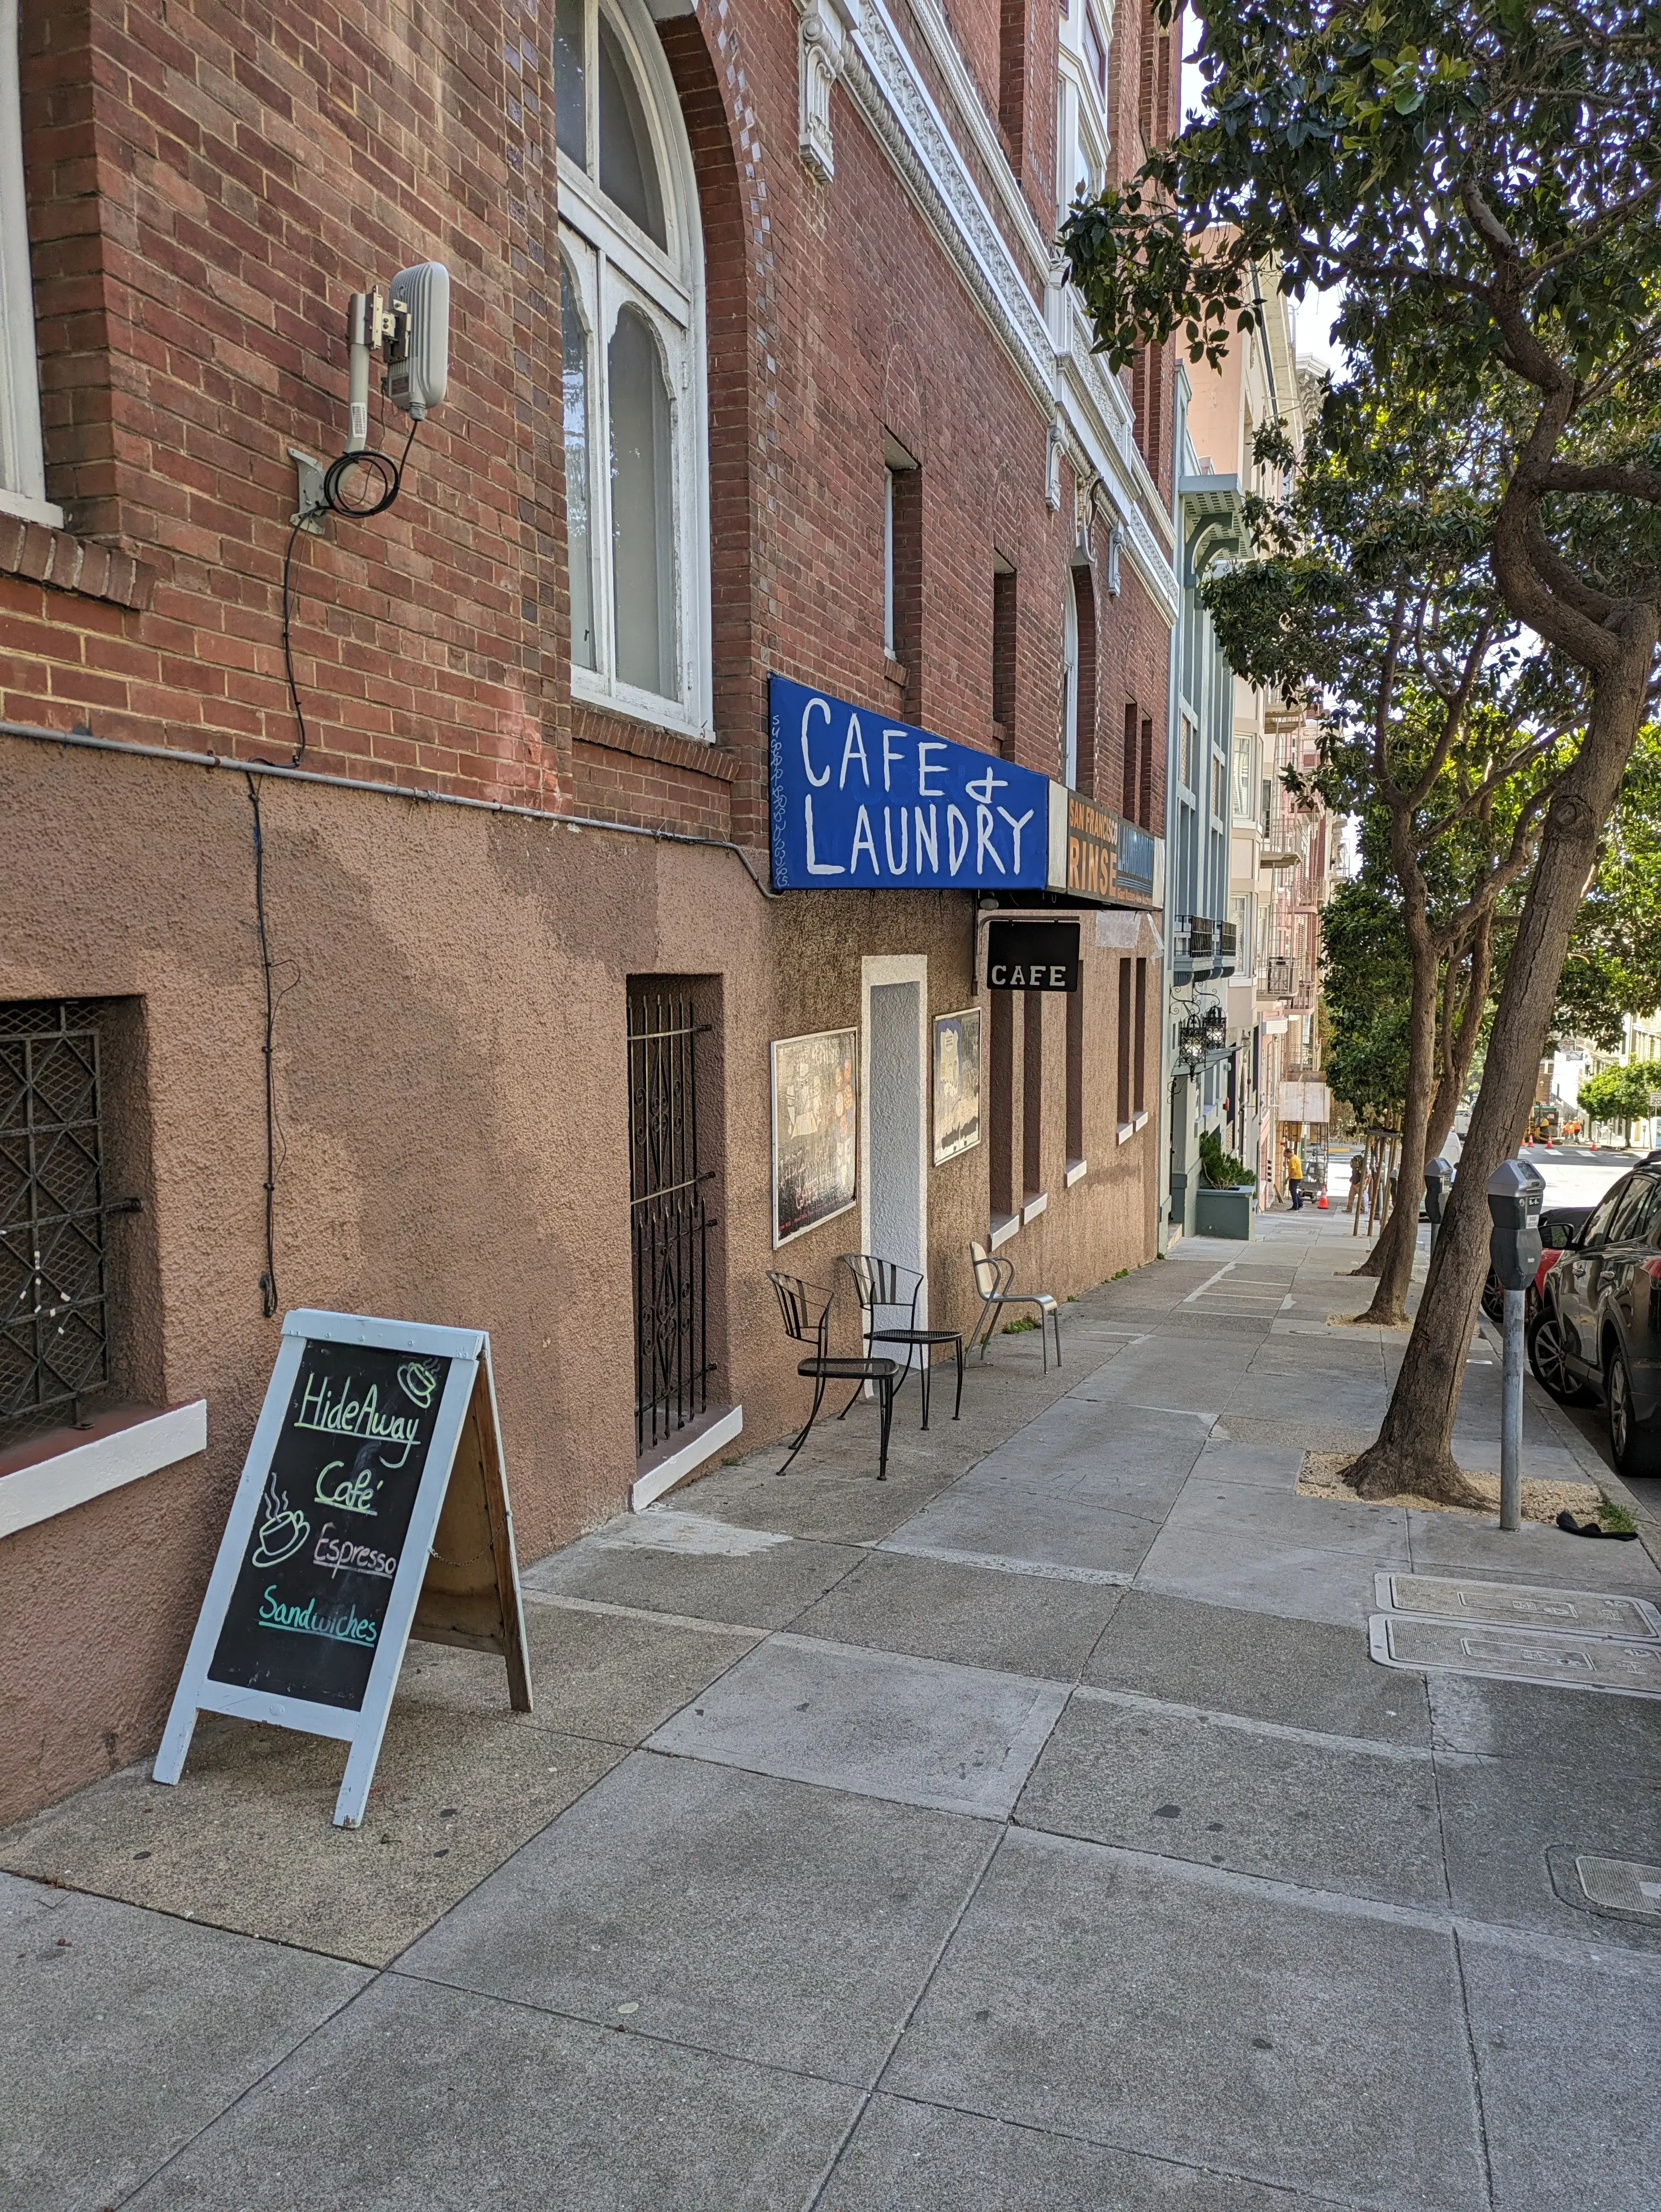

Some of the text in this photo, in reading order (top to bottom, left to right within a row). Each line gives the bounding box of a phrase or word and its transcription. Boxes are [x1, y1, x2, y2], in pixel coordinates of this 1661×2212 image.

[801, 697, 949, 796] CAFE
[805, 793, 1034, 877] LAUNDRY
[1069, 798, 1118, 846] SAN FRANCISCO
[1069, 836, 1117, 897] RINSE
[992, 965, 1066, 986] CAFE
[299, 1372, 420, 1468] HideAway
[313, 1522, 397, 1579] Espresso
[259, 1584, 377, 1641] Sandwiches
